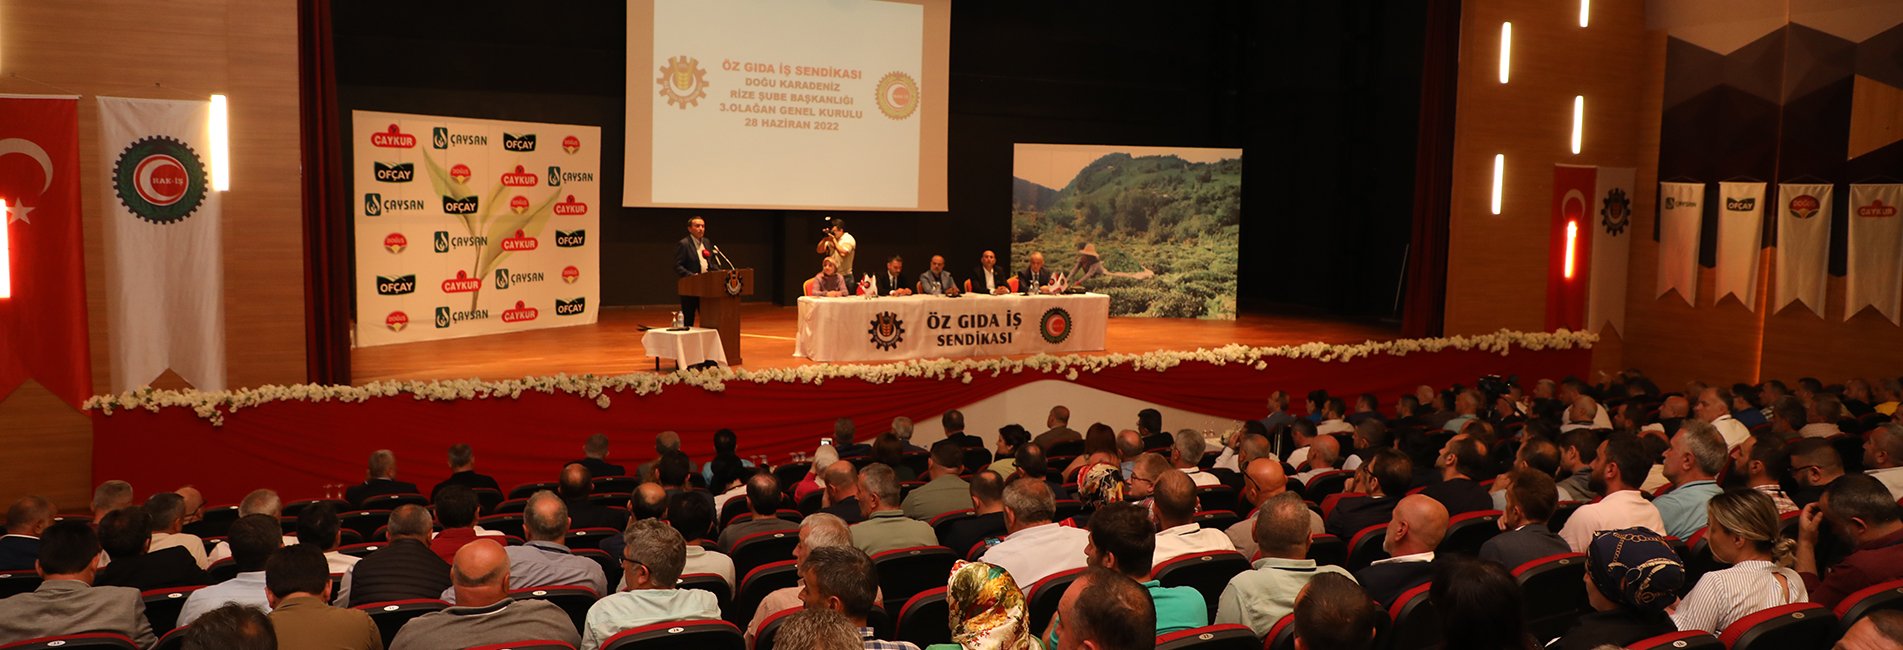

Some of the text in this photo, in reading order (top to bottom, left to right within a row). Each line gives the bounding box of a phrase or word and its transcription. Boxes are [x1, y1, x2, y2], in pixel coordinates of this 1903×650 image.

[722, 58, 862, 80] ÖZ GIDA İŞ SENDİKASI
[745, 77, 841, 92] DOĞU KARADENİZ
[730, 88, 854, 106] RİZE ŞUBE BAŞKANLIĞI
[719, 102, 863, 119] 3.OLAĞAN GENEL KURULU
[744, 117, 840, 131] 28 HAZİRAN 2022
[450, 134, 488, 147] ÇAYSAN
[505, 140, 534, 151] OFÇAY
[377, 170, 412, 181] OFÇAY
[562, 172, 594, 184] ÇAYSAN
[383, 200, 425, 213] ÇAYSAN
[445, 202, 476, 213] OFÇAY
[451, 236, 488, 249] ÇAYSAN
[558, 236, 584, 247] OFÇAY
[511, 272, 544, 285] ÇAYSAN
[380, 282, 414, 294] OFÇAY
[558, 303, 584, 314] OFÇAY
[452, 309, 489, 324] ÇAYSAN
[927, 310, 1022, 330] ÖZ GIDA İŞ
[937, 331, 1013, 347] SENDİKASI
